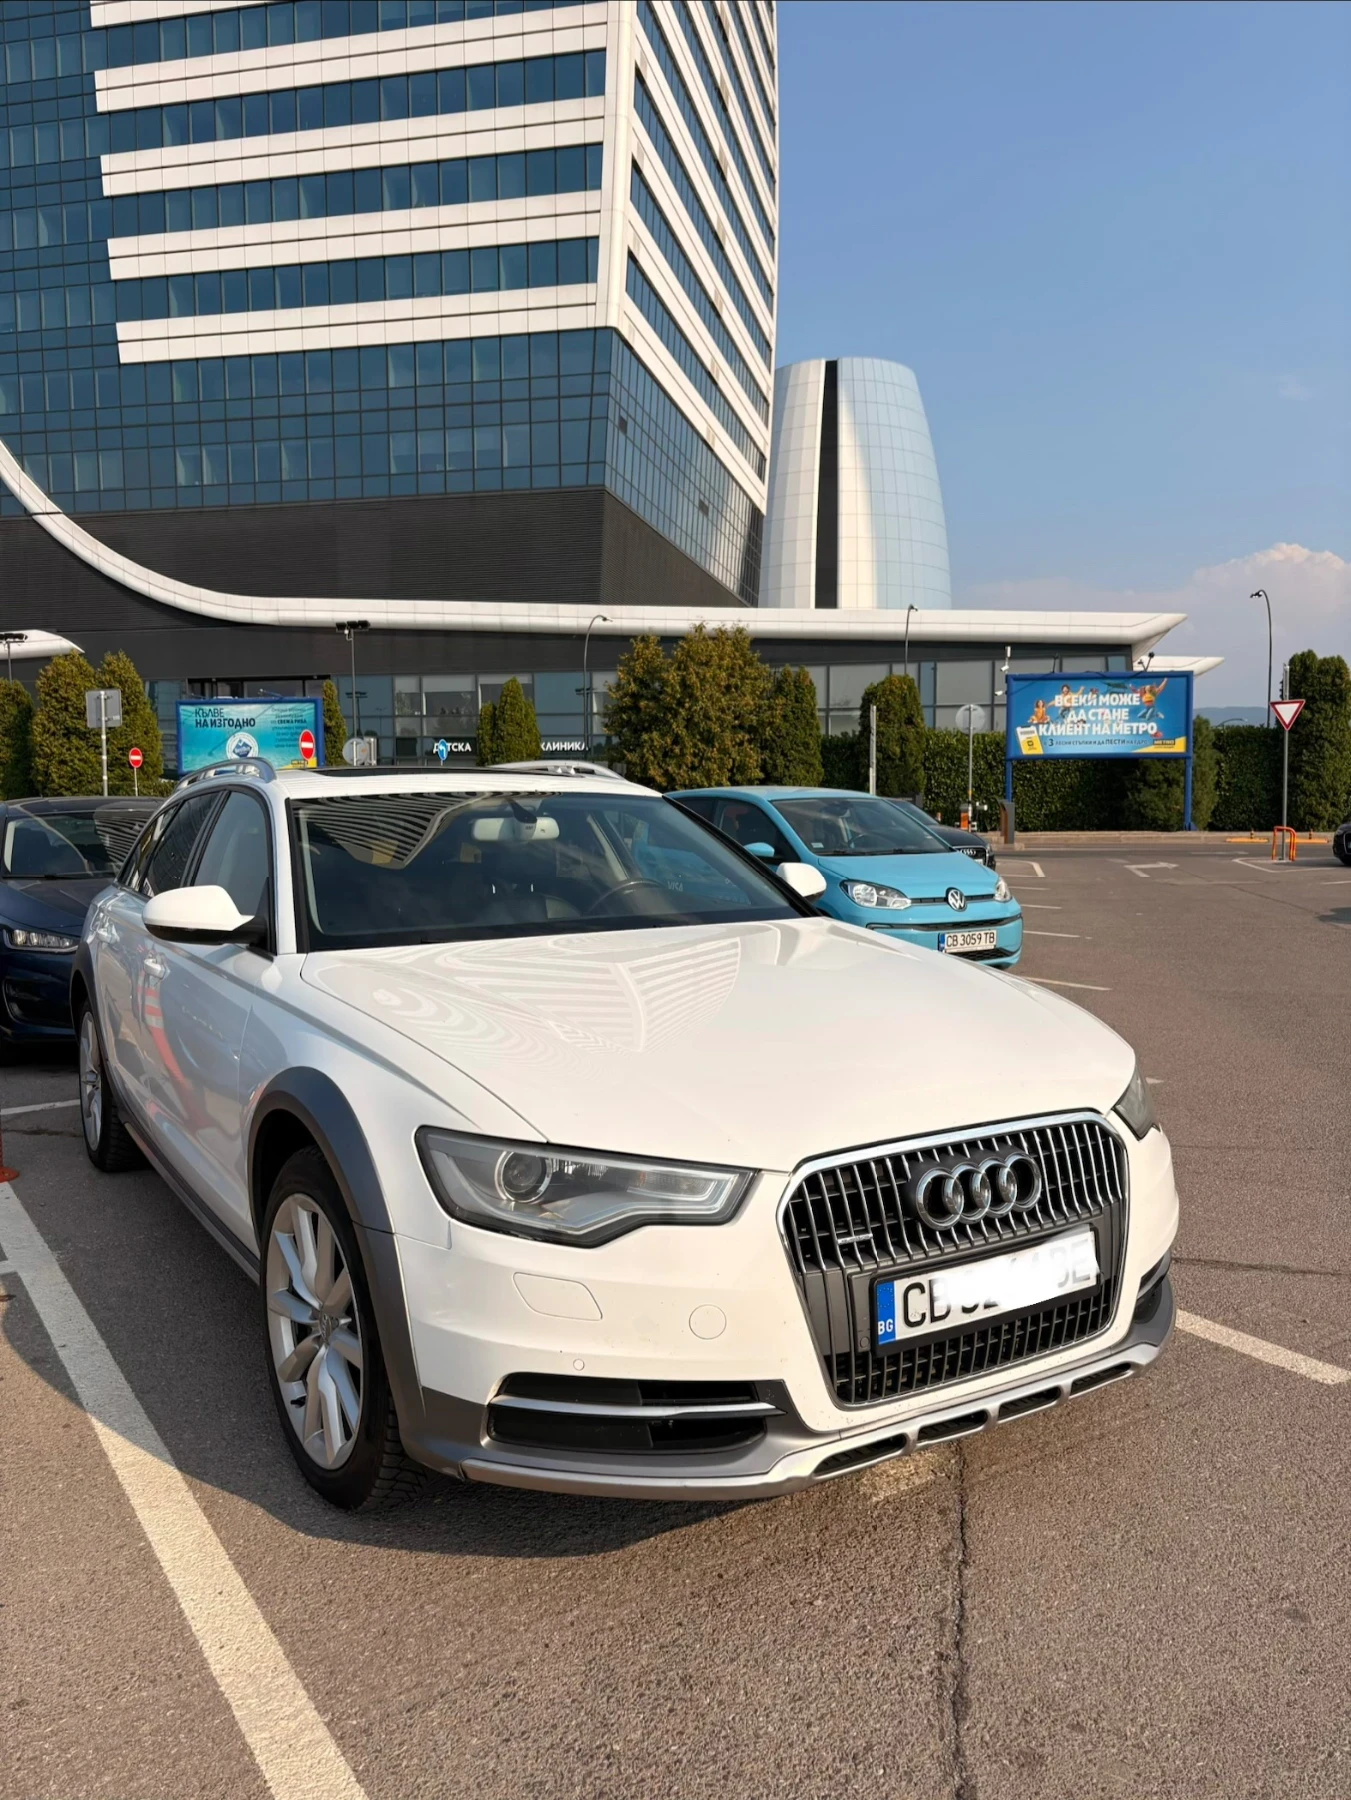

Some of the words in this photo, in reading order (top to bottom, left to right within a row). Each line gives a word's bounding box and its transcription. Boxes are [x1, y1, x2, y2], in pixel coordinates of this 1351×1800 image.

[1055, 693, 1097, 707] ВСЕКИ
[1099, 693, 1140, 706] МОЖЕ
[195, 708, 224, 718] КЪЛВЕ
[1067, 708, 1087, 722] ДА
[1088, 708, 1129, 720] СТАНЕ
[195, 718, 210, 728] НА
[210, 718, 256, 729] ИЗГОДНО
[1039, 722, 1091, 736] КЛИЕНТ
[1092, 722, 1111, 735] НА
[1112, 722, 1157, 735] МЕТРО
[433, 742, 472, 753] ДТСКА
[1048, 738, 1054, 747] 3
[960, 933, 982, 946] 3059
[877, 1318, 894, 1336] BG
